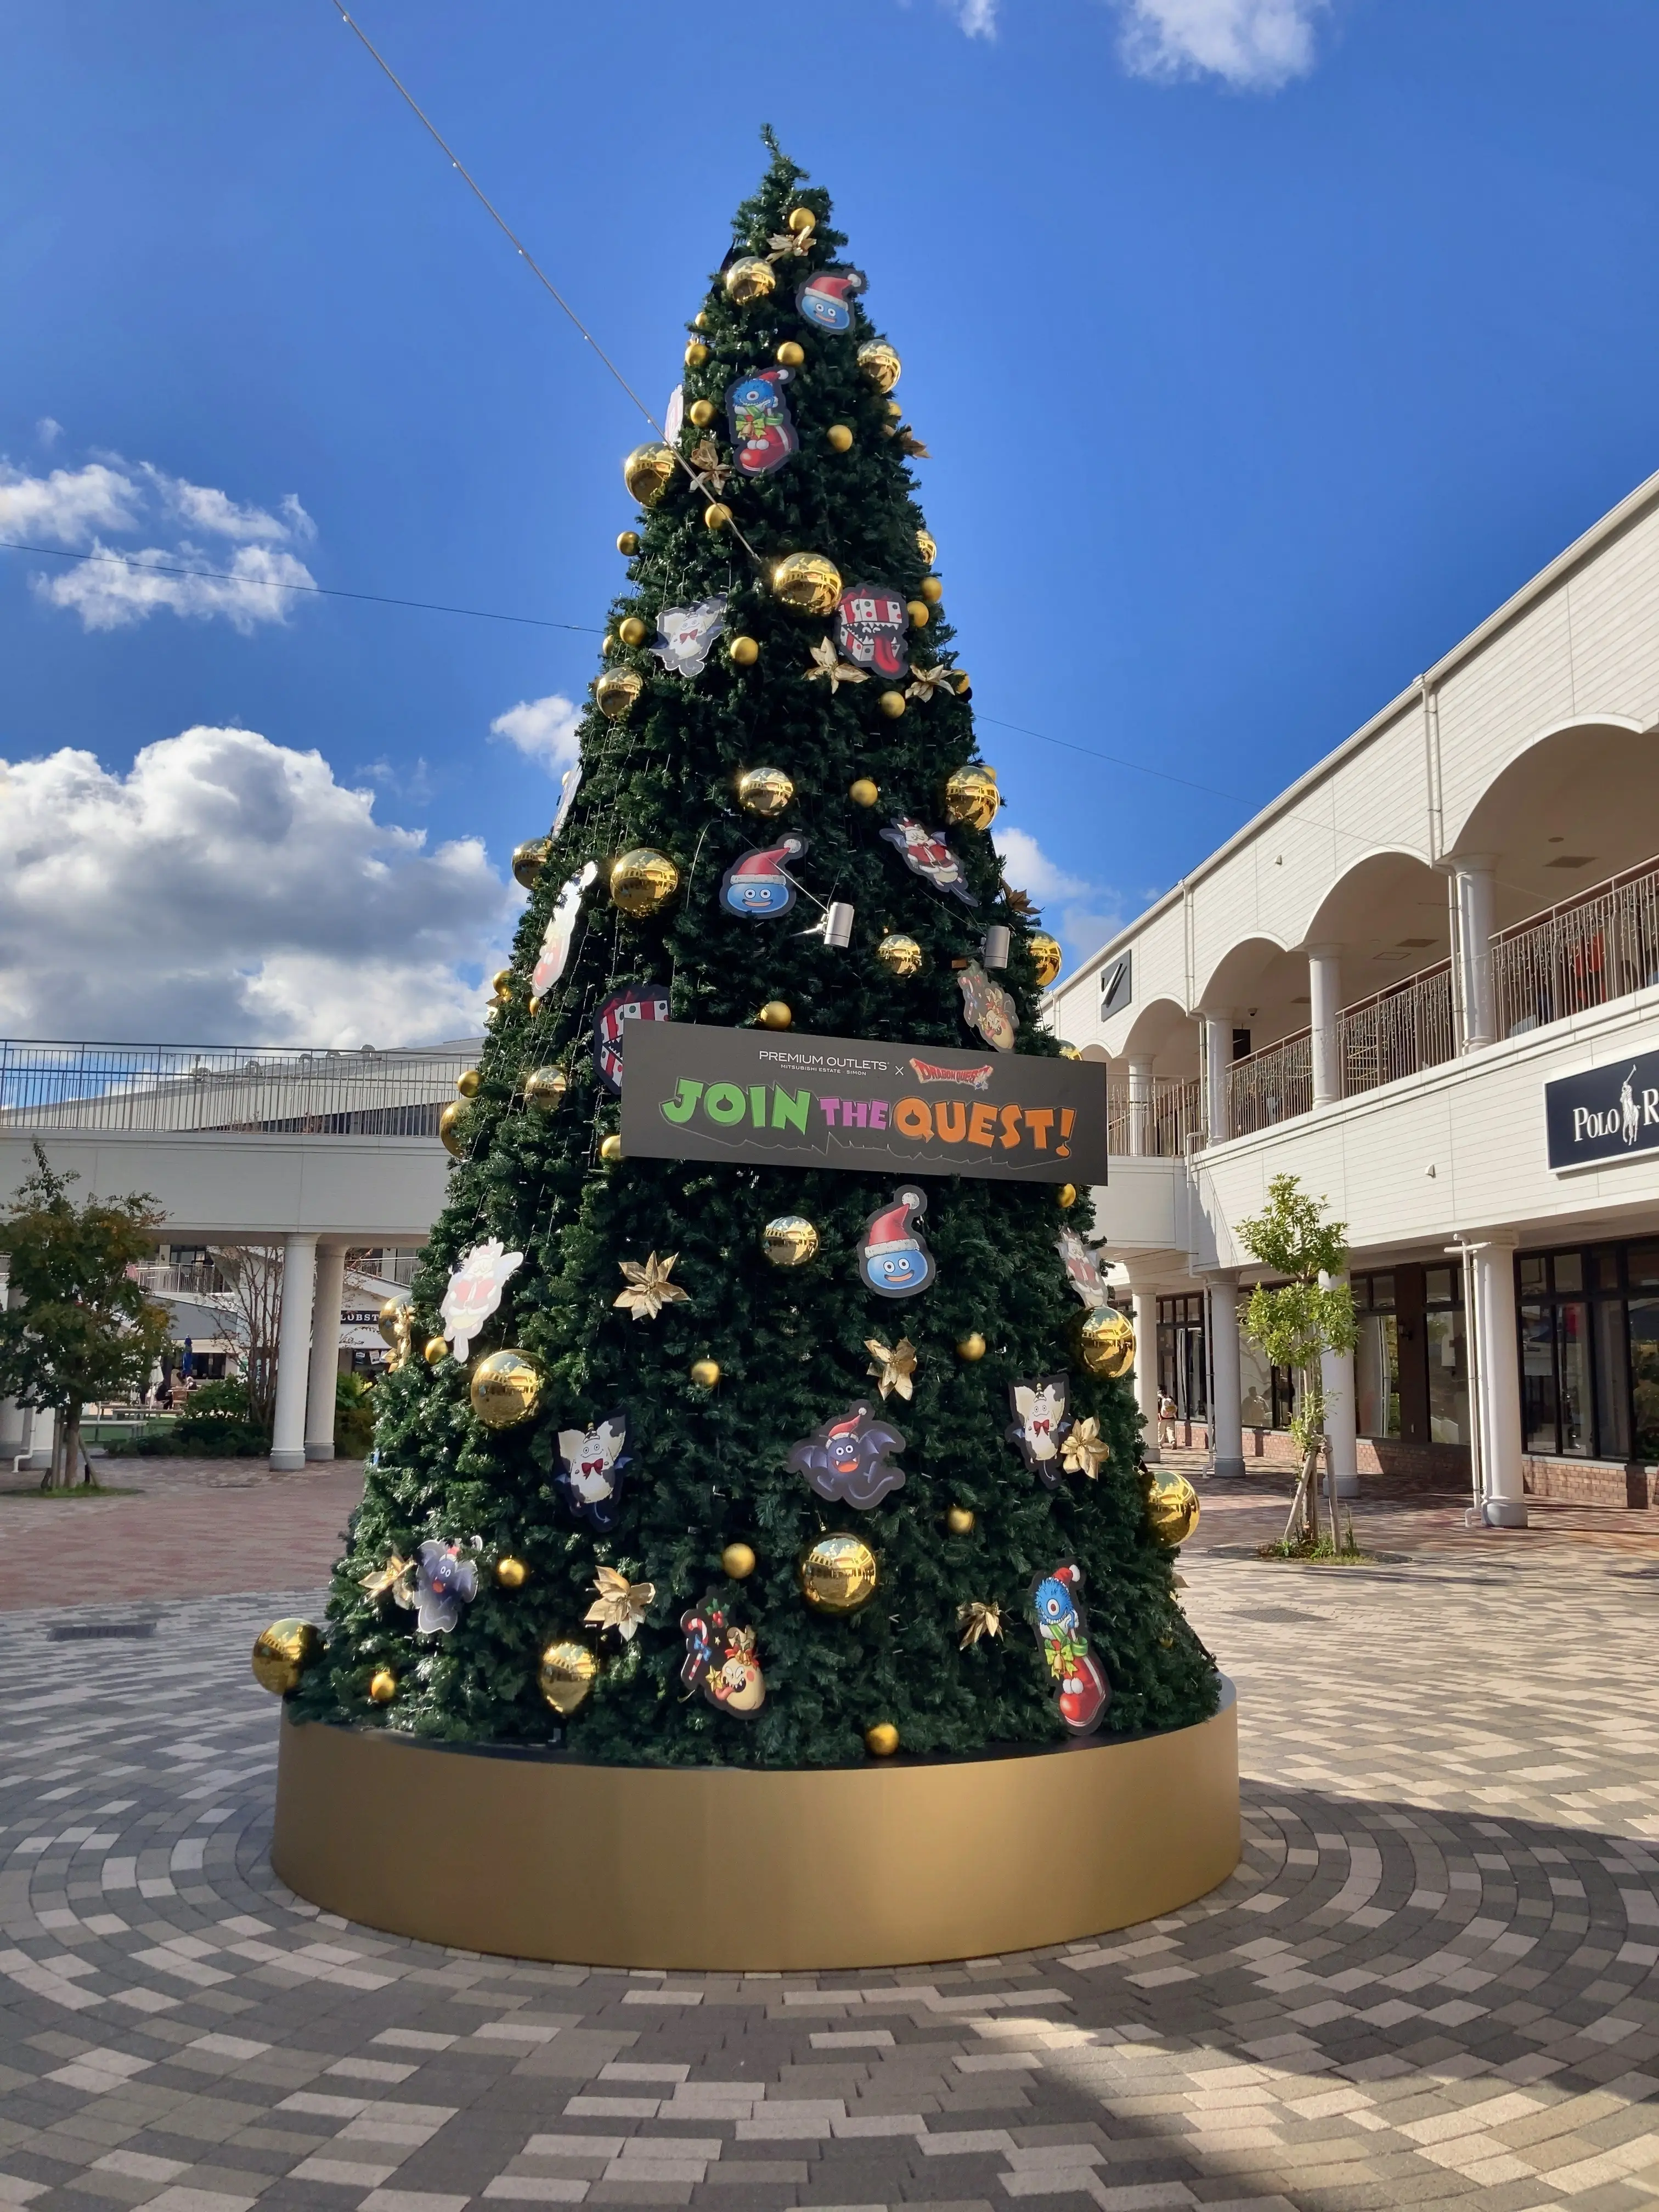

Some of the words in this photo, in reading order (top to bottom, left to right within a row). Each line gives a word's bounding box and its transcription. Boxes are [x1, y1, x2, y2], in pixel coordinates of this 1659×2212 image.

[759, 1050, 823, 1065] PREMIUM
[827, 1057, 887, 1071] OUTLETS
[661, 1077, 812, 1136] JOIN
[820, 1097, 890, 1130] THE
[894, 1097, 1076, 1158] QUEST!
